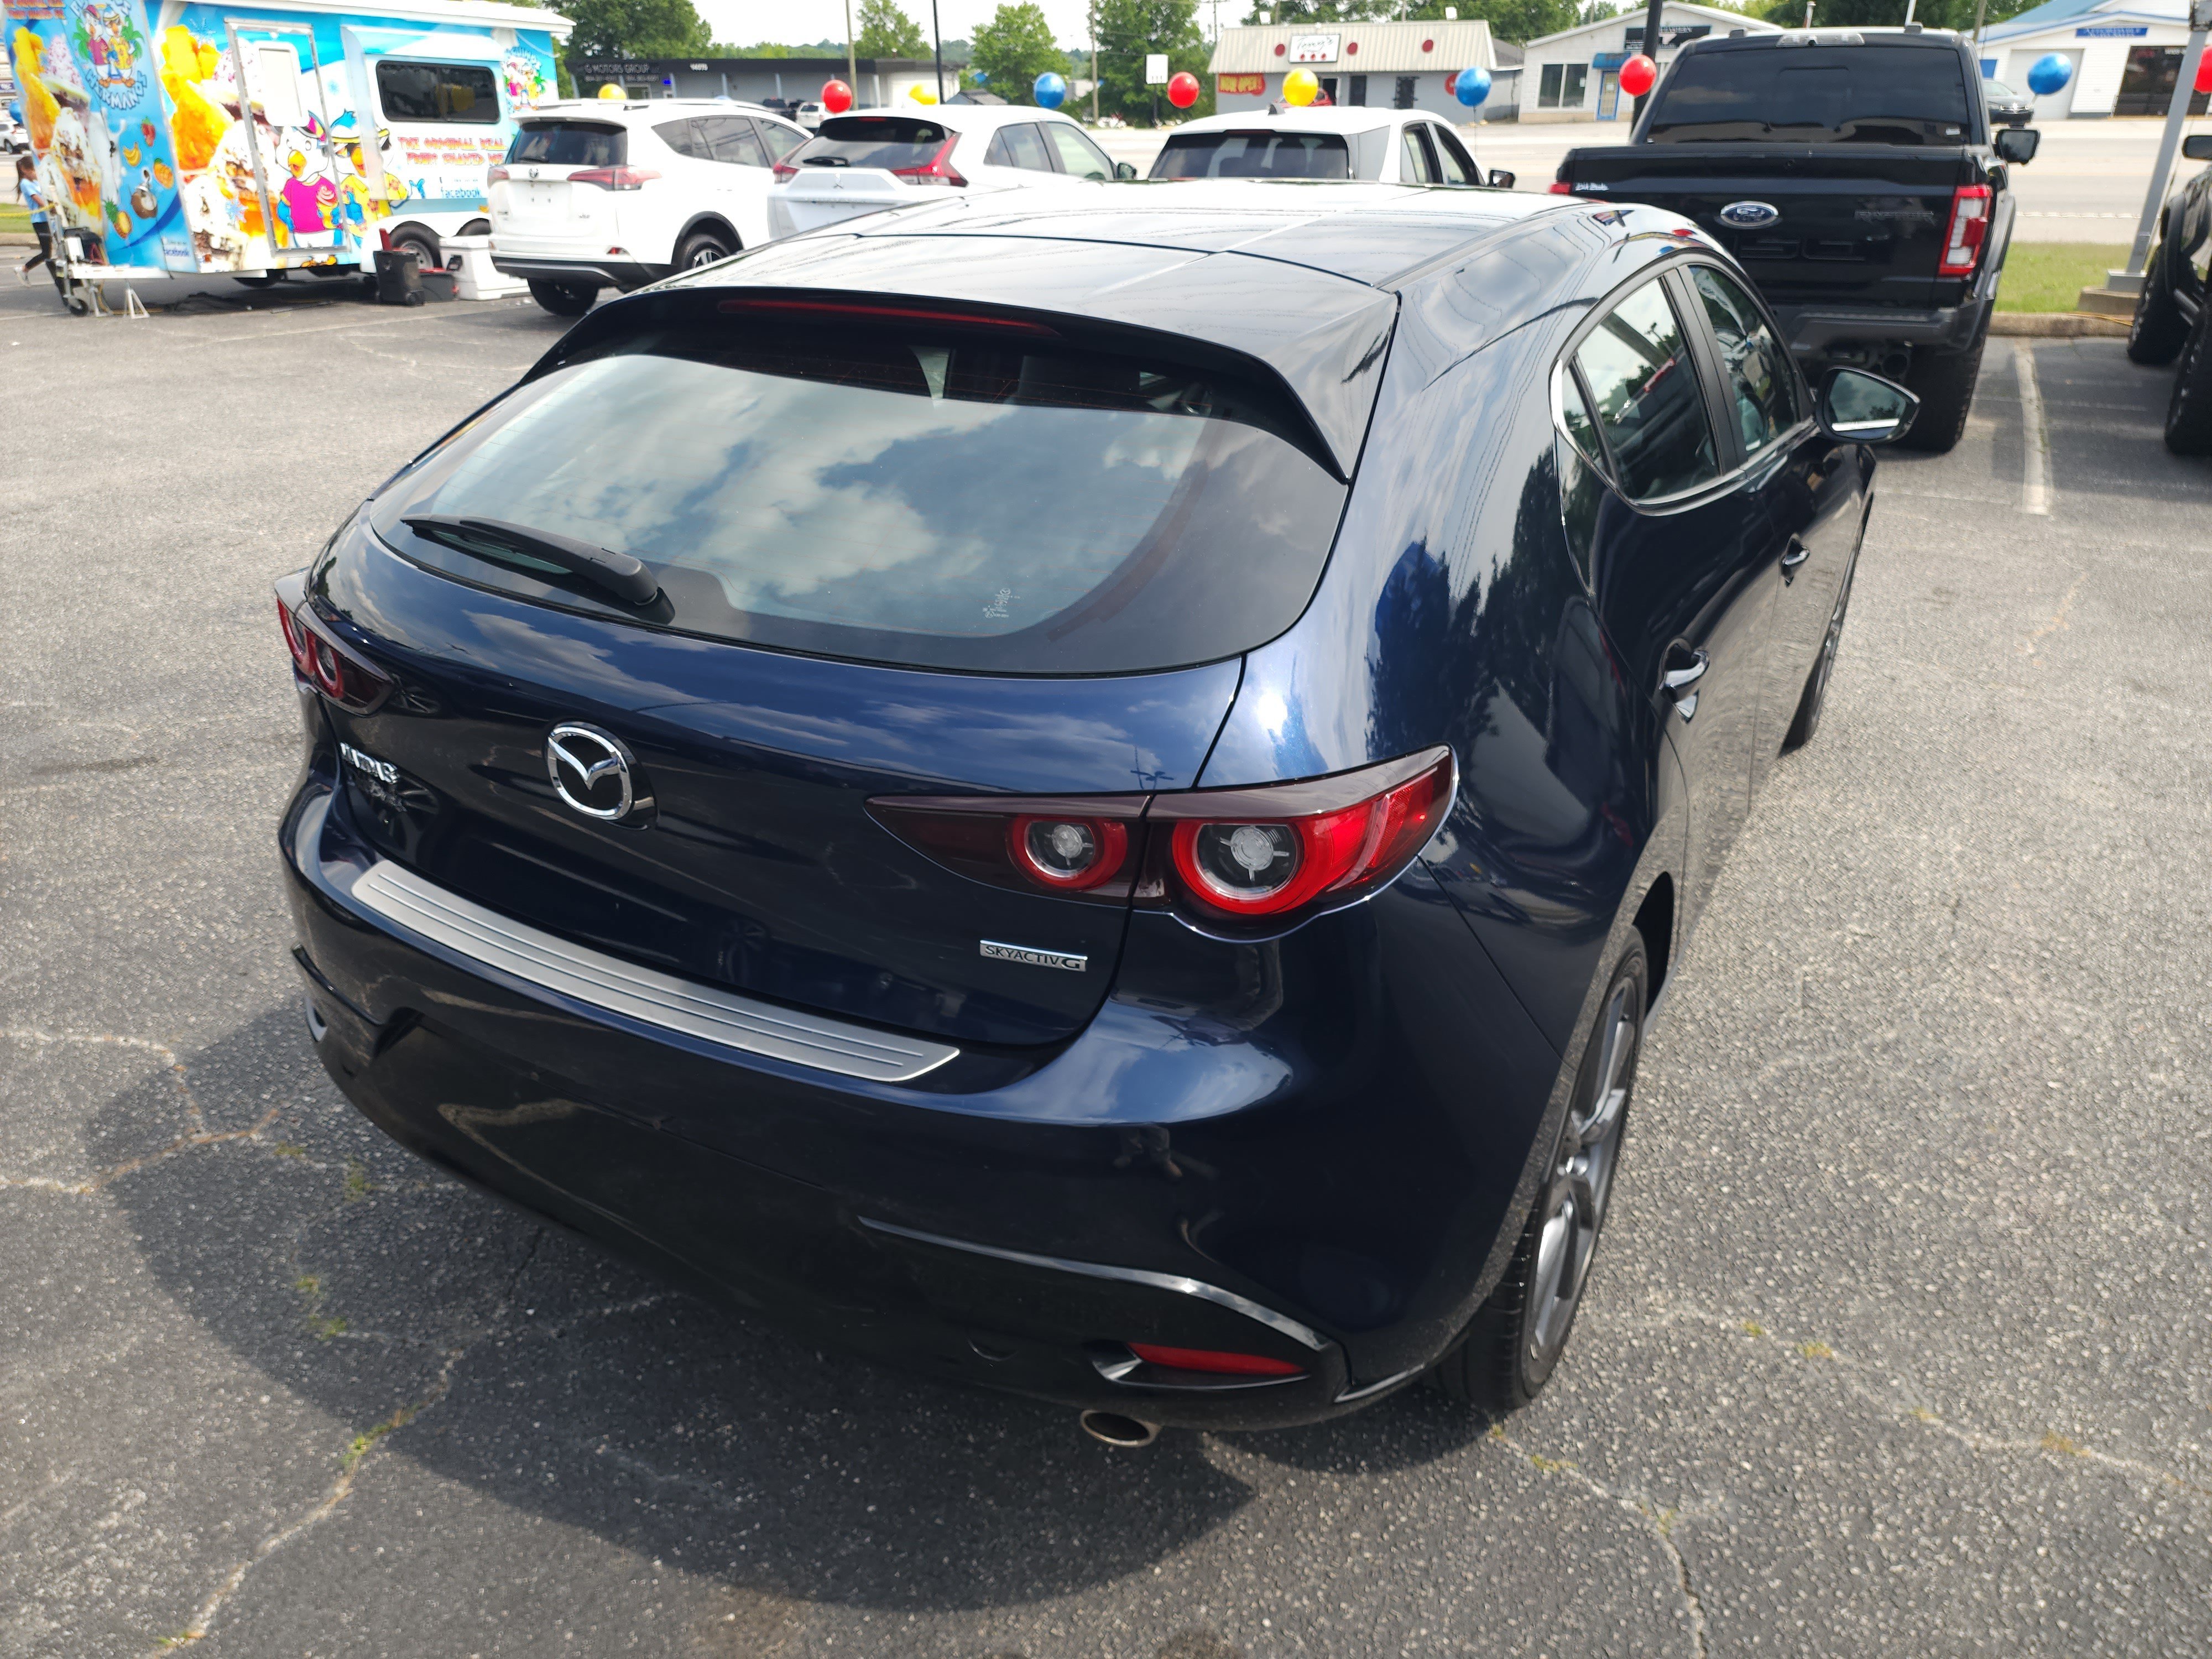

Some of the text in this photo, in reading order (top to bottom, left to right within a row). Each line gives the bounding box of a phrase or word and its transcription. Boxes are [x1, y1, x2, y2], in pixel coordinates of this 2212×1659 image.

[624, 64, 650, 73] GROUP
[1220, 76, 1238, 92] NOW
[398, 137, 508, 151] THE ORIGINAL REAL
[442, 153, 484, 165] SHAVED
